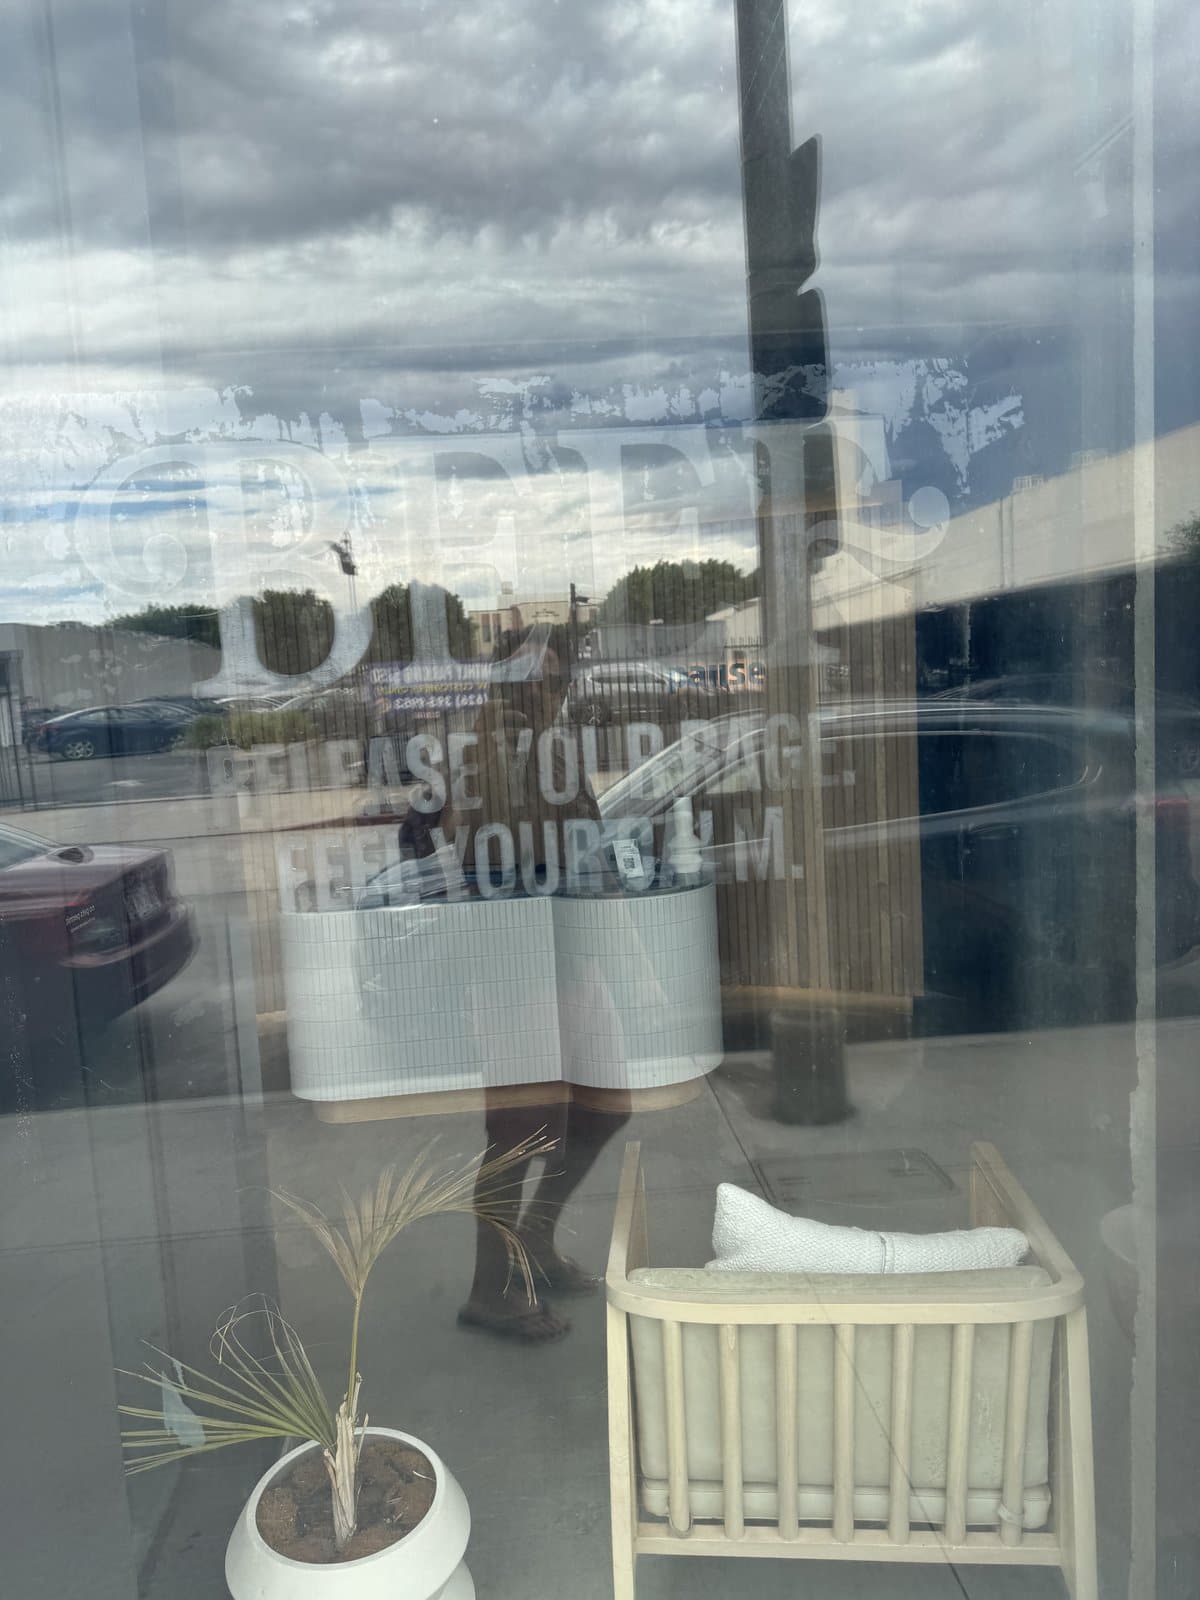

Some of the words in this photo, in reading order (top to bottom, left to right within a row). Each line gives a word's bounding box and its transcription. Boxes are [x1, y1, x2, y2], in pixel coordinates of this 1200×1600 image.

[206, 730, 483, 831] RELEASE
[494, 721, 666, 809] YOUR
[679, 712, 856, 799] RAGE.
[276, 824, 422, 914] FEEL
[430, 816, 622, 904] YOUR
